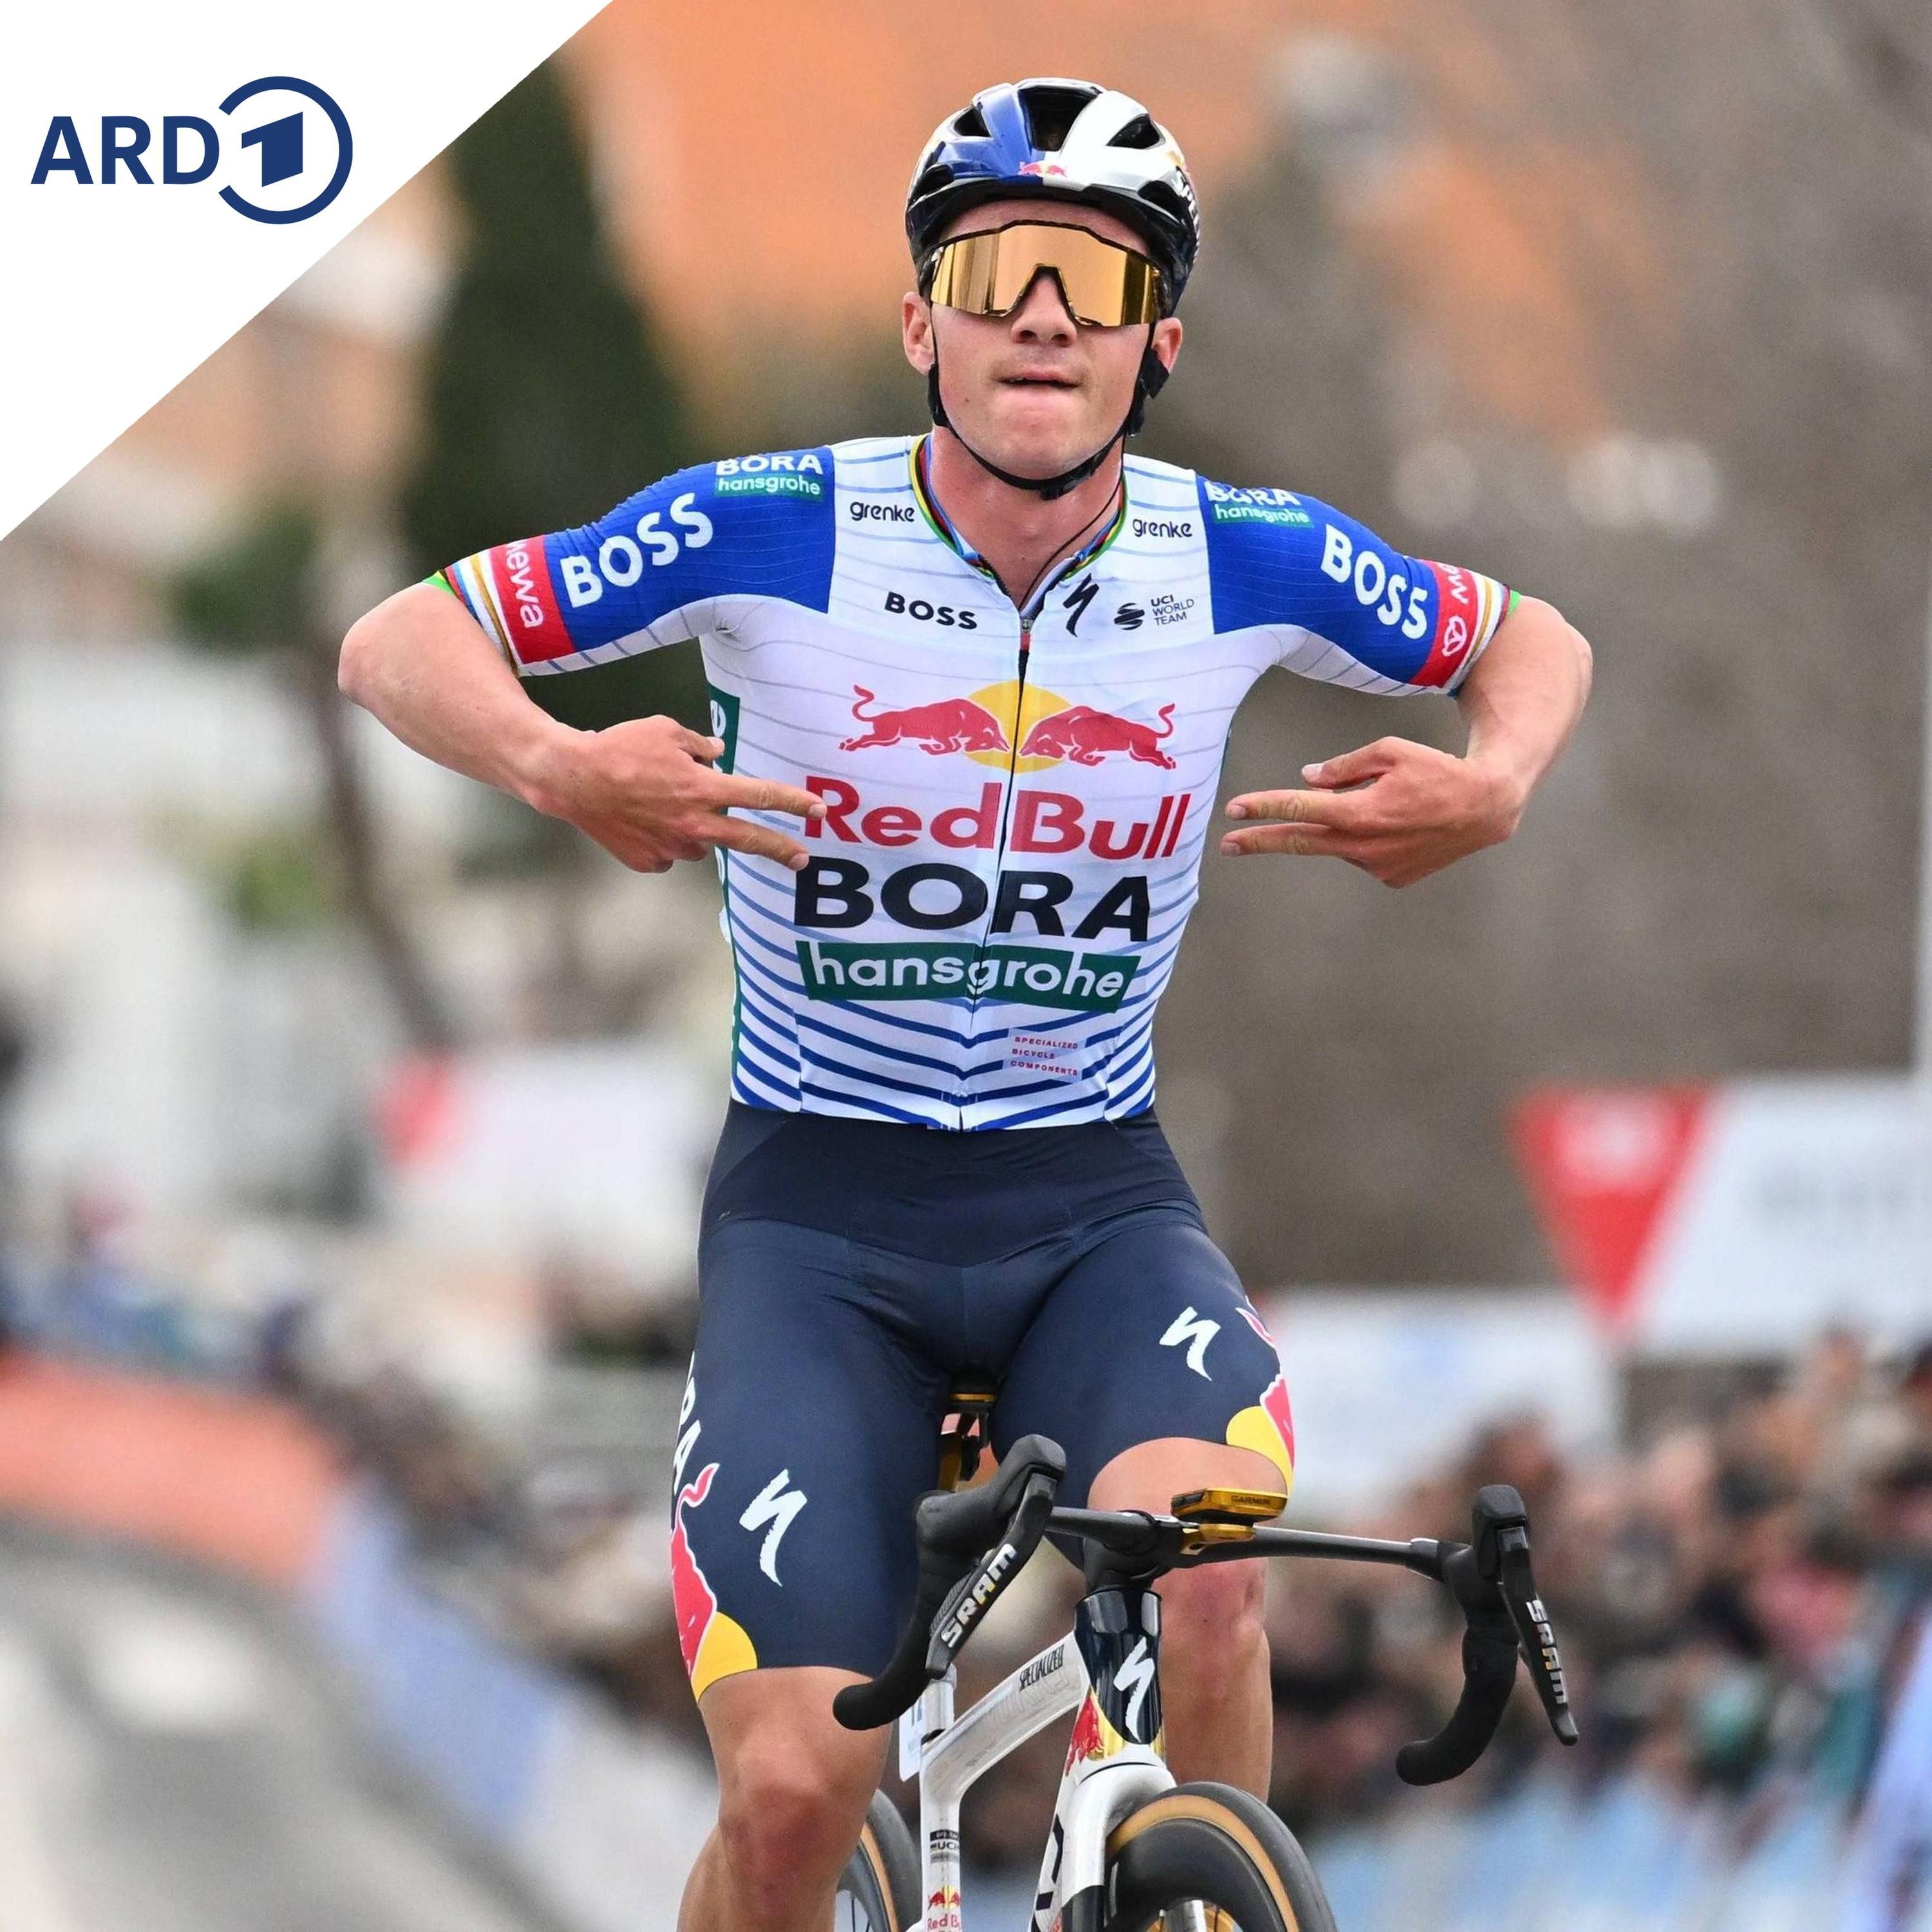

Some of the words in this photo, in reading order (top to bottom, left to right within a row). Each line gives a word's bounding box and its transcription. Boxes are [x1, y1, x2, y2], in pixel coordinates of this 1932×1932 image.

[715, 454, 824, 476] BORA
[718, 475, 820, 495] hansgrohe
[849, 501, 915, 522] grenke
[1132, 518, 1193, 538] grenke
[559, 492, 713, 609] BOSS
[1320, 524, 1428, 639] BOSS
[884, 591, 978, 630] BOSS
[1150, 594, 1174, 607] UCI
[1152, 598, 1195, 616] WORLD
[1154, 611, 1187, 625] TEAM
[793, 855, 1150, 942] BORA
[806, 945, 1125, 998] hansgrohe
[1014, 1037, 1078, 1049] SPECIALIZED
[1012, 1048, 1055, 1059] BICYCLE
[1010, 1060, 1077, 1075] COMPONENTS
[1230, 1495, 1271, 1505] GARMIN
[941, 1543, 1018, 1649] SRAM
[1526, 1599, 1567, 1704] SRAM
